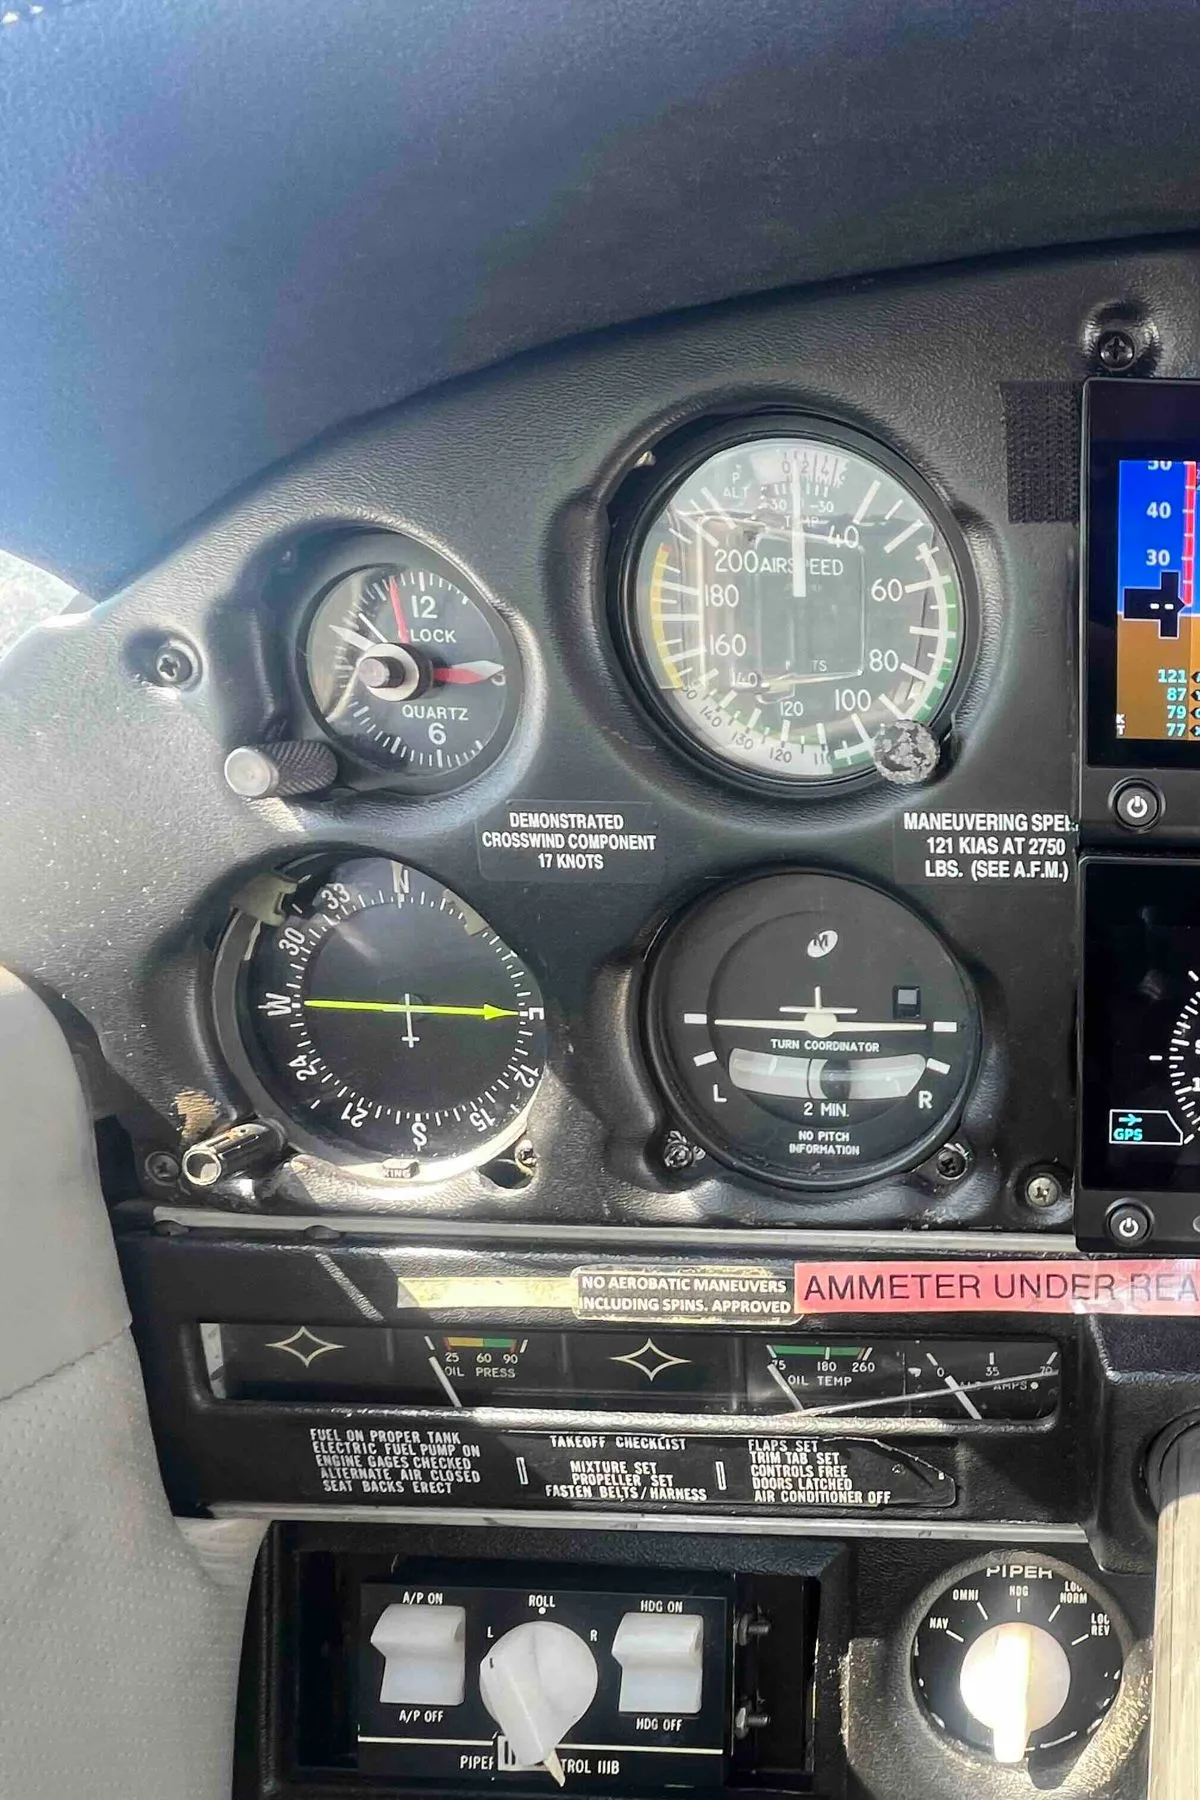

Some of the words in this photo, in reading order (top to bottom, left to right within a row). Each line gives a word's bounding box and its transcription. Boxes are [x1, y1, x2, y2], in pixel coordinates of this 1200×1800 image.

[715, 550, 758, 573] 200
[871, 578, 902, 602] 60
[411, 595, 438, 619] 12
[869, 650, 898, 672] 80
[835, 689, 871, 711] 100
[402, 705, 469, 721] QUARTZ
[509, 813, 623, 829] DEMONSTRATED
[904, 812, 1028, 831] MANEUVERING
[482, 832, 565, 849] CROSSWIND
[568, 834, 656, 850] COMPONENT
[927, 837, 953, 853] 121
[959, 837, 999, 854] KIAS
[1002, 837, 1025, 854] AT
[1029, 838, 1065, 855] 2750
[538, 853, 552, 868] 17
[557, 854, 604, 869] KNOTS
[925, 860, 963, 877] LBS.
[971, 860, 1010, 881] (SEE
[1014, 861, 1069, 882] A.F.M.)
[771, 1039, 800, 1049] TURN
[805, 1040, 880, 1053] COORDINATOR
[804, 1102, 813, 1115] 2
[821, 1104, 850, 1117] MIN.
[799, 1130, 814, 1141] NO
[818, 1131, 850, 1141] PITCH
[1113, 1129, 1142, 1141] GPS
[789, 1143, 859, 1155] INFORMATION
[582, 1276, 605, 1289] NO
[608, 1276, 690, 1291] AEROBATIC
[693, 1278, 786, 1293] MANEUVERS
[804, 1274, 980, 1301] AMMETER
[994, 1274, 1115, 1301] UNDER
[580, 1297, 659, 1311] INCLUDING
[712, 1300, 791, 1314] APPROVED
[445, 1367, 464, 1378] OIL
[476, 1367, 516, 1379] PRESS
[816, 1361, 836, 1372] 180
[852, 1362, 875, 1373] 260
[788, 1375, 809, 1386] OIL
[817, 1376, 852, 1386] TEMP
[550, 1435, 605, 1448] TAKEOFF
[616, 1436, 686, 1450] CHECKLIST
[749, 1440, 788, 1452] FLAPS
[795, 1440, 818, 1452] SET
[751, 1452, 781, 1464] TRIM
[787, 1452, 808, 1465] TAB
[816, 1453, 840, 1465] SET
[570, 1461, 627, 1473] MIXTURE
[635, 1462, 657, 1475] SET
[751, 1465, 814, 1478] CONTROLS
[818, 1466, 848, 1478] FREE
[572, 1473, 641, 1487] PROPELLER
[651, 1475, 673, 1487] SET
[545, 1485, 592, 1498] FASTEN
[986, 1565, 1052, 1579] PIPER
[953, 1590, 979, 1600] OMNI
[1010, 1586, 1028, 1596] HDG
[403, 1592, 424, 1604] A/P
[428, 1593, 443, 1605] ON
[529, 1595, 556, 1607] ROLL
[640, 1601, 663, 1613] HDG
[667, 1601, 683, 1613] ON
[930, 1618, 948, 1629] NAV
[399, 1710, 421, 1722] A/P
[424, 1711, 444, 1722] OFF
[636, 1718, 659, 1730] HDG
[663, 1720, 682, 1731] OFF
